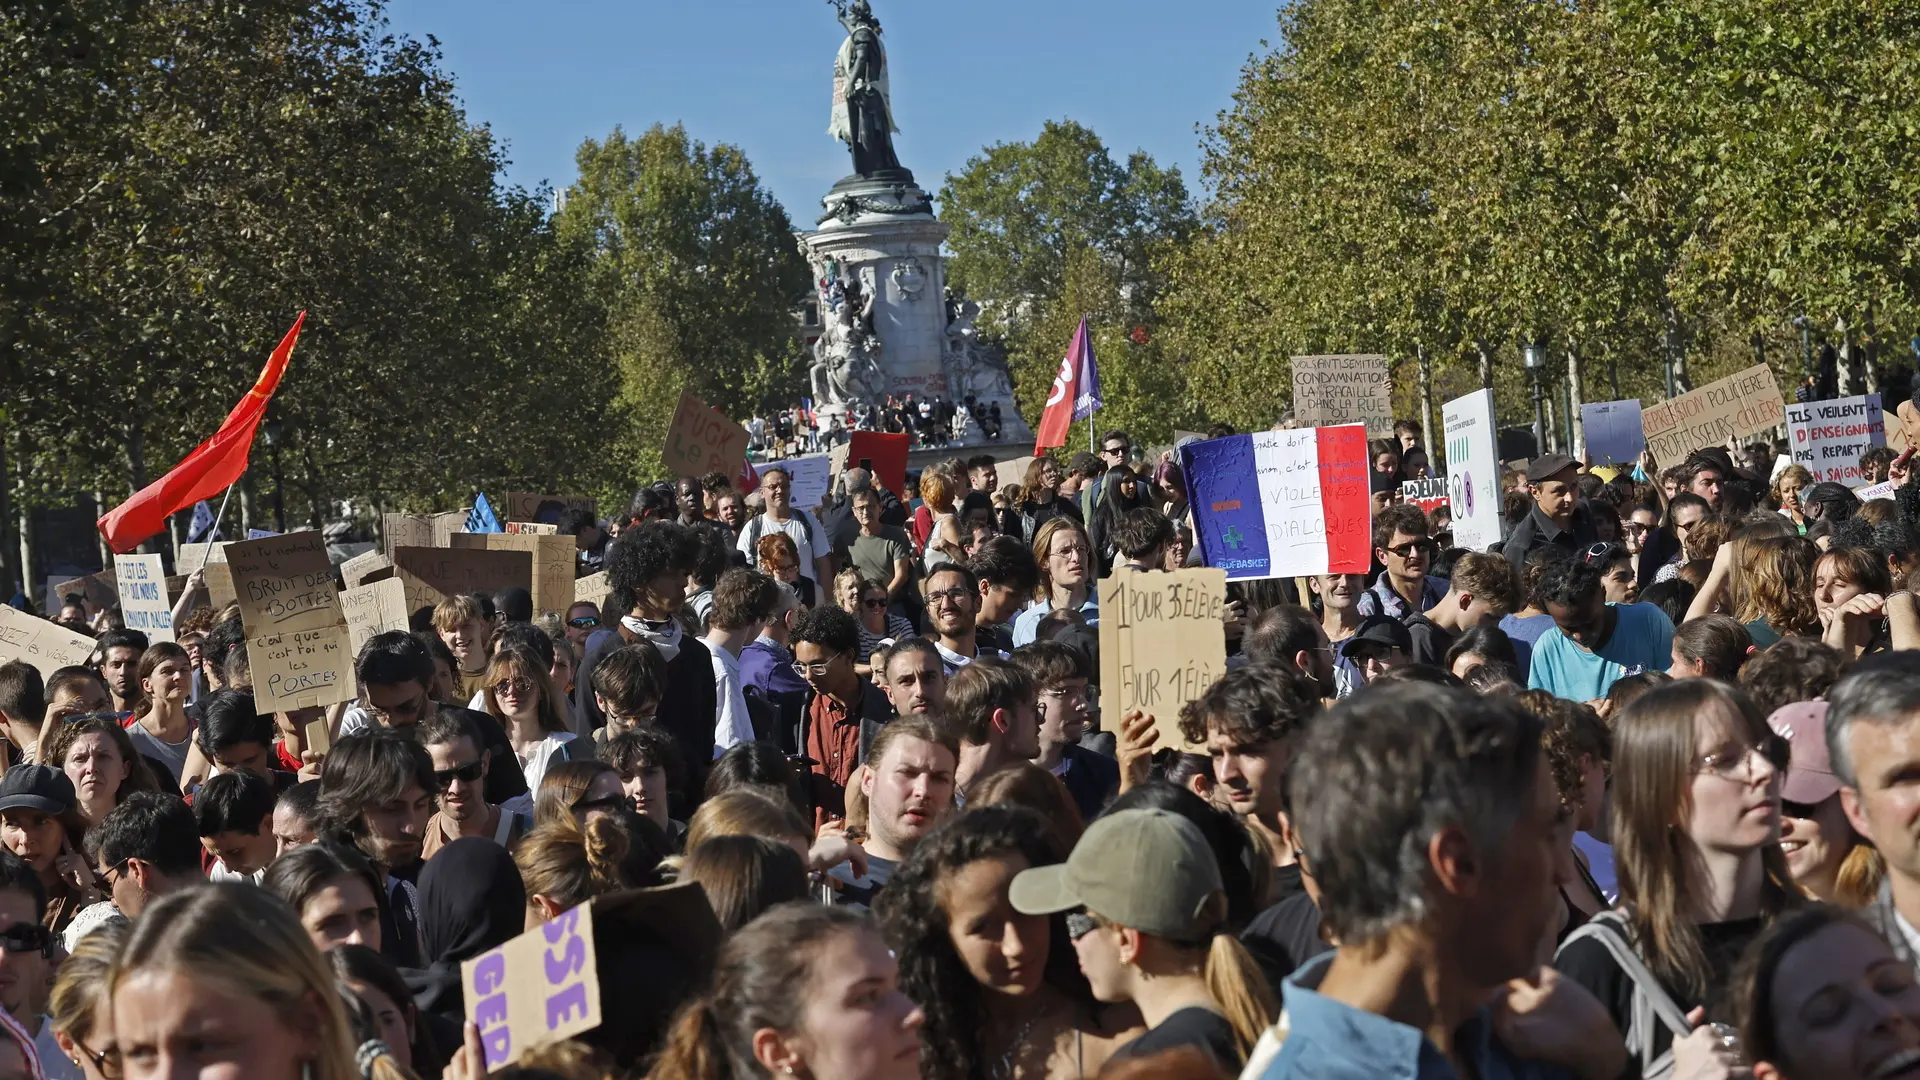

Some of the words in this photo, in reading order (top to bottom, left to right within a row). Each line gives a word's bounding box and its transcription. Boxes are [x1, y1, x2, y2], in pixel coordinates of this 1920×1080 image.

[1301, 386, 1316, 398] LA
[1308, 399, 1336, 410] DANS
[1340, 399, 1352, 409] LA
[1357, 397, 1386, 413] RUE
[1331, 407, 1349, 419] OU
[1736, 396, 1785, 430] COLÈRE
[1788, 408, 1813, 424] ILS
[1817, 403, 1867, 419] VEULENT
[678, 396, 736, 455] FUCK
[1286, 434, 1310, 448] doit
[1795, 448, 1815, 461] PAS
[1286, 459, 1311, 474] c'est
[1404, 485, 1417, 496] LA
[1863, 486, 1886, 497] VOUS
[508, 497, 533, 519] ILS
[507, 525, 521, 535] ON
[257, 545, 271, 557] tu
[140, 582, 159, 601] NOUS
[246, 574, 299, 602] BRUIT
[304, 572, 332, 588] DES
[268, 590, 333, 617] BOTTES
[1107, 581, 1131, 629] 1
[1130, 588, 1164, 622] POUR
[257, 632, 283, 648] c'est
[294, 631, 321, 647] que
[268, 647, 293, 660] c'est
[298, 647, 316, 655] toi
[323, 641, 339, 653] qui
[288, 661, 309, 670] les
[267, 670, 338, 697] PORTES
[1169, 667, 1182, 704] 1
[473, 945, 512, 1069] GER
